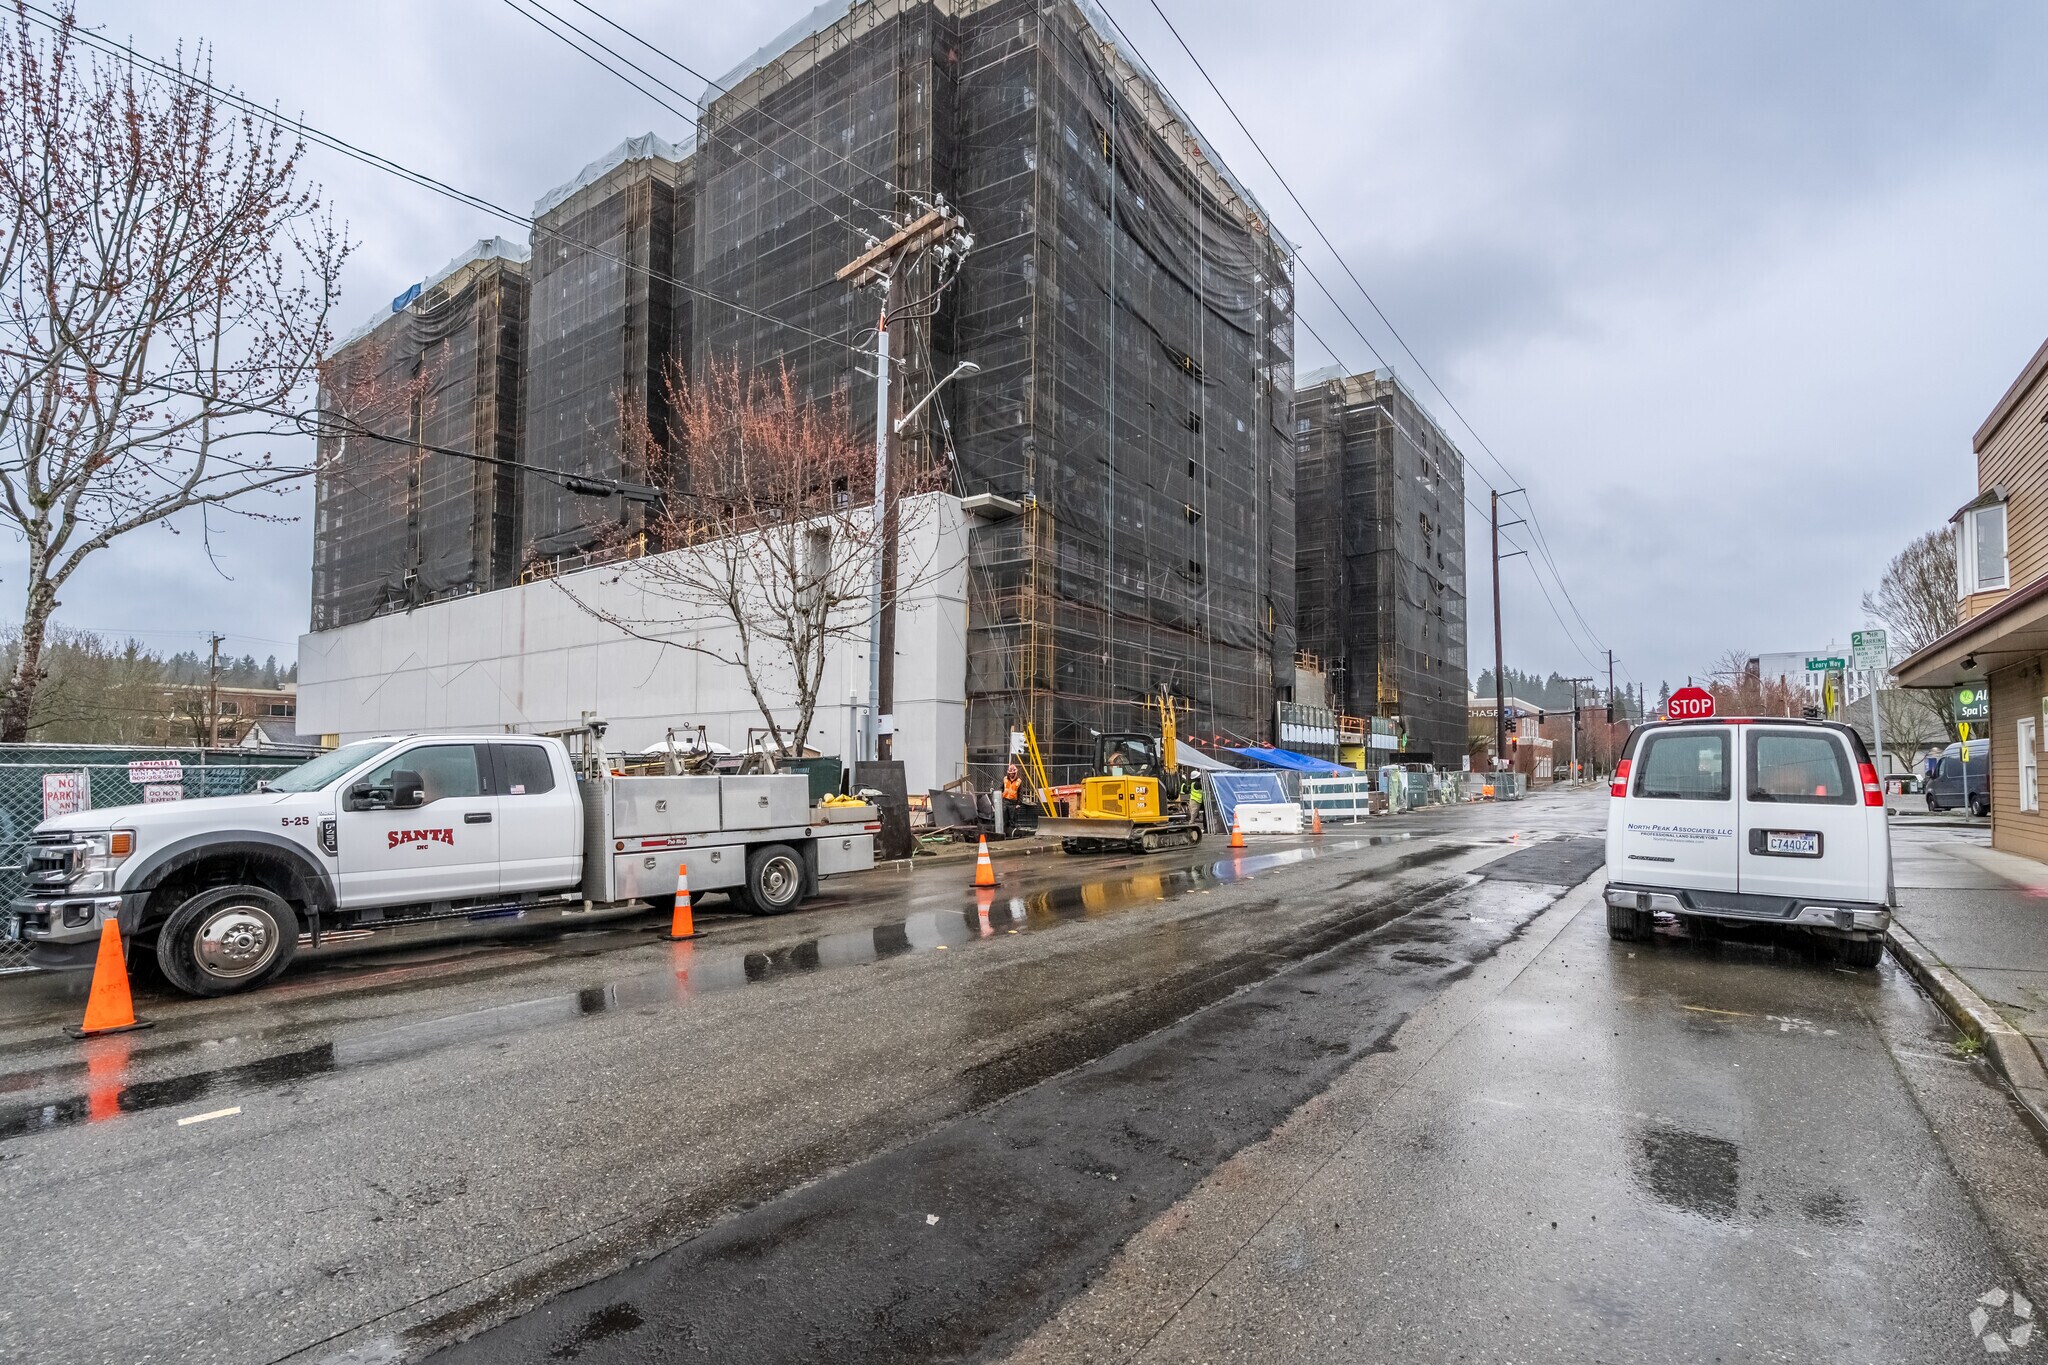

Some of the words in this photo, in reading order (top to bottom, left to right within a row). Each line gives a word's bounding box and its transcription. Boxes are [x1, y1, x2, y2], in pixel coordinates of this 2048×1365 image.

[1853, 635, 1861, 645] 2
[1812, 661, 1828, 669] Leary
[1975, 689, 1989, 701] Al
[1671, 698, 1712, 715] STOP
[1961, 706, 1978, 717] Spa
[1135, 786, 1146, 794] CAT
[281, 816, 310, 826] 5-25
[1672, 825, 1715, 834] ASSOCIATES
[387, 828, 455, 849] SANTA
